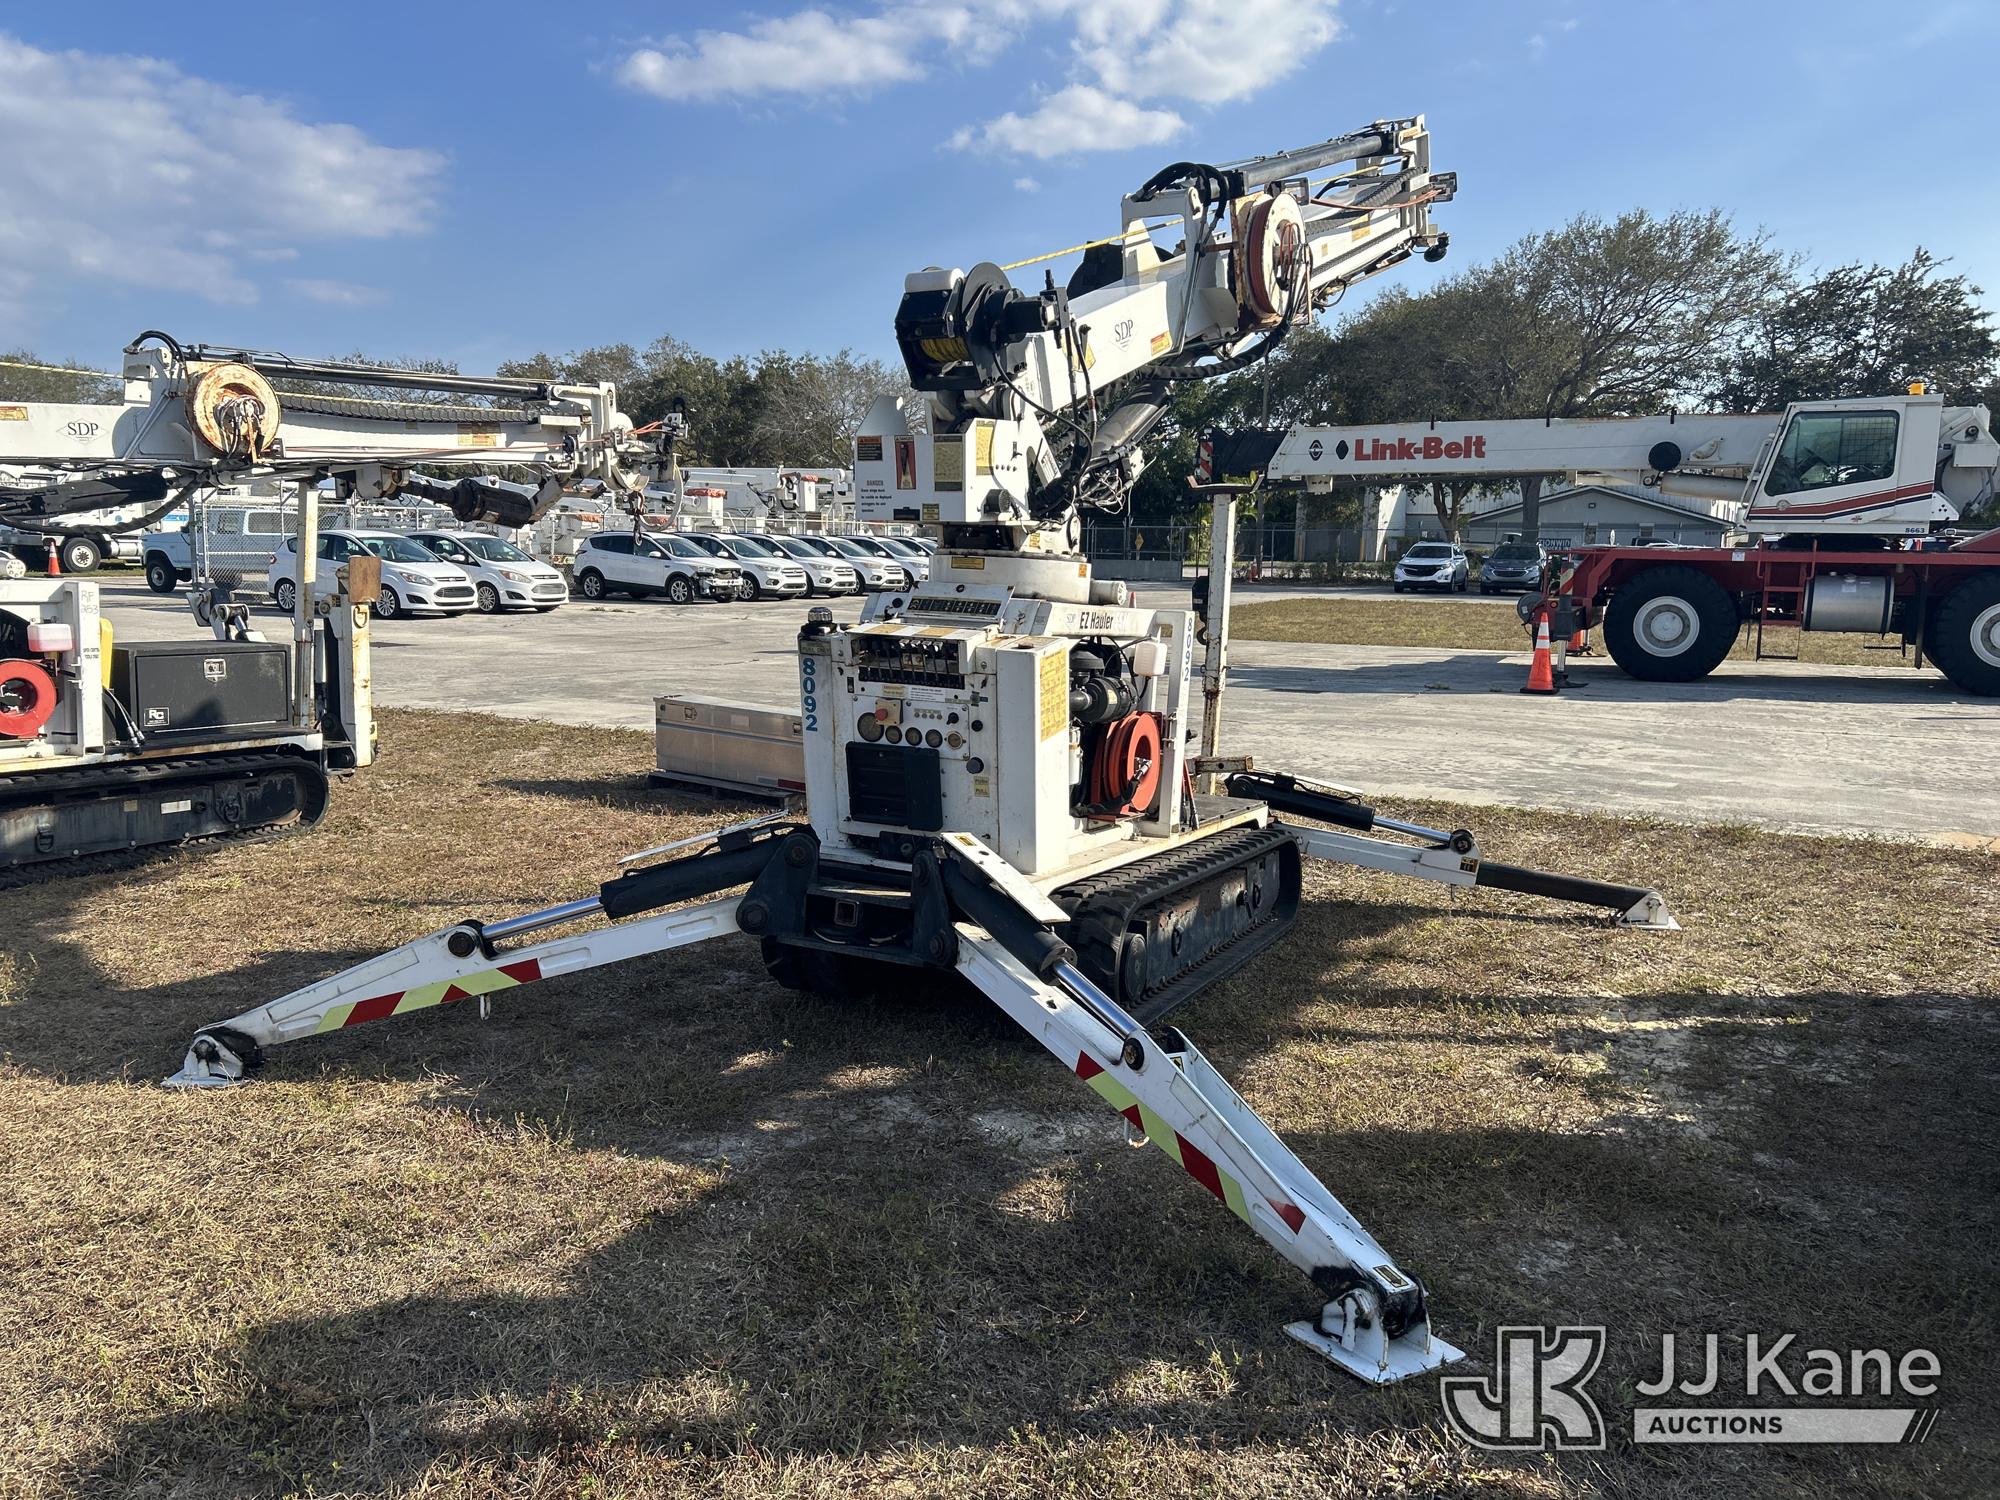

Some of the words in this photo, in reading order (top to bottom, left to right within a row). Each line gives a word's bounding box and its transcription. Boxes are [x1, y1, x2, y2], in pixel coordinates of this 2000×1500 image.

[1114, 319, 1134, 342] SDP
[67, 422, 99, 436] SDP
[1354, 435, 1486, 461] Link-Belt
[1079, 611, 1090, 630] EZ
[1090, 611, 1114, 630] Hauler
[1183, 617, 1193, 682] 8092
[803, 657, 818, 732] 8092
